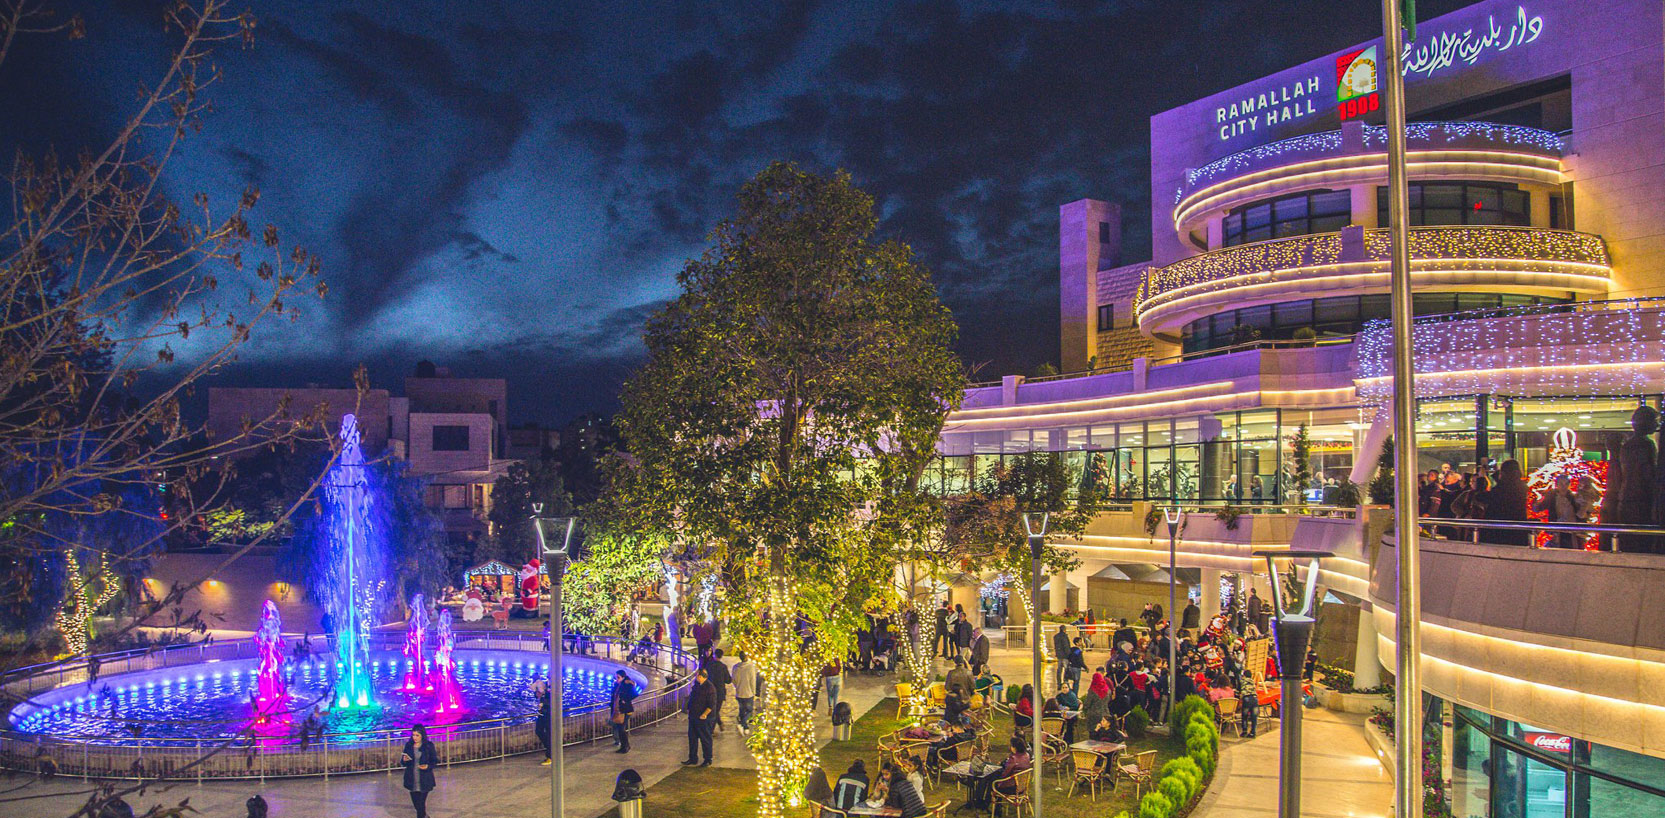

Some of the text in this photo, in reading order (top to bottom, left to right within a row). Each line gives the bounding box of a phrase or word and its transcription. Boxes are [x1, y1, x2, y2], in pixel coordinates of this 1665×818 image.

[1459, 15, 1501, 65] بلدية
[1499, 5, 1543, 51] دار
[1216, 76, 1319, 123] RAMALLAH
[1220, 99, 1316, 140] CITY HALL
[1337, 93, 1379, 121] 1908
